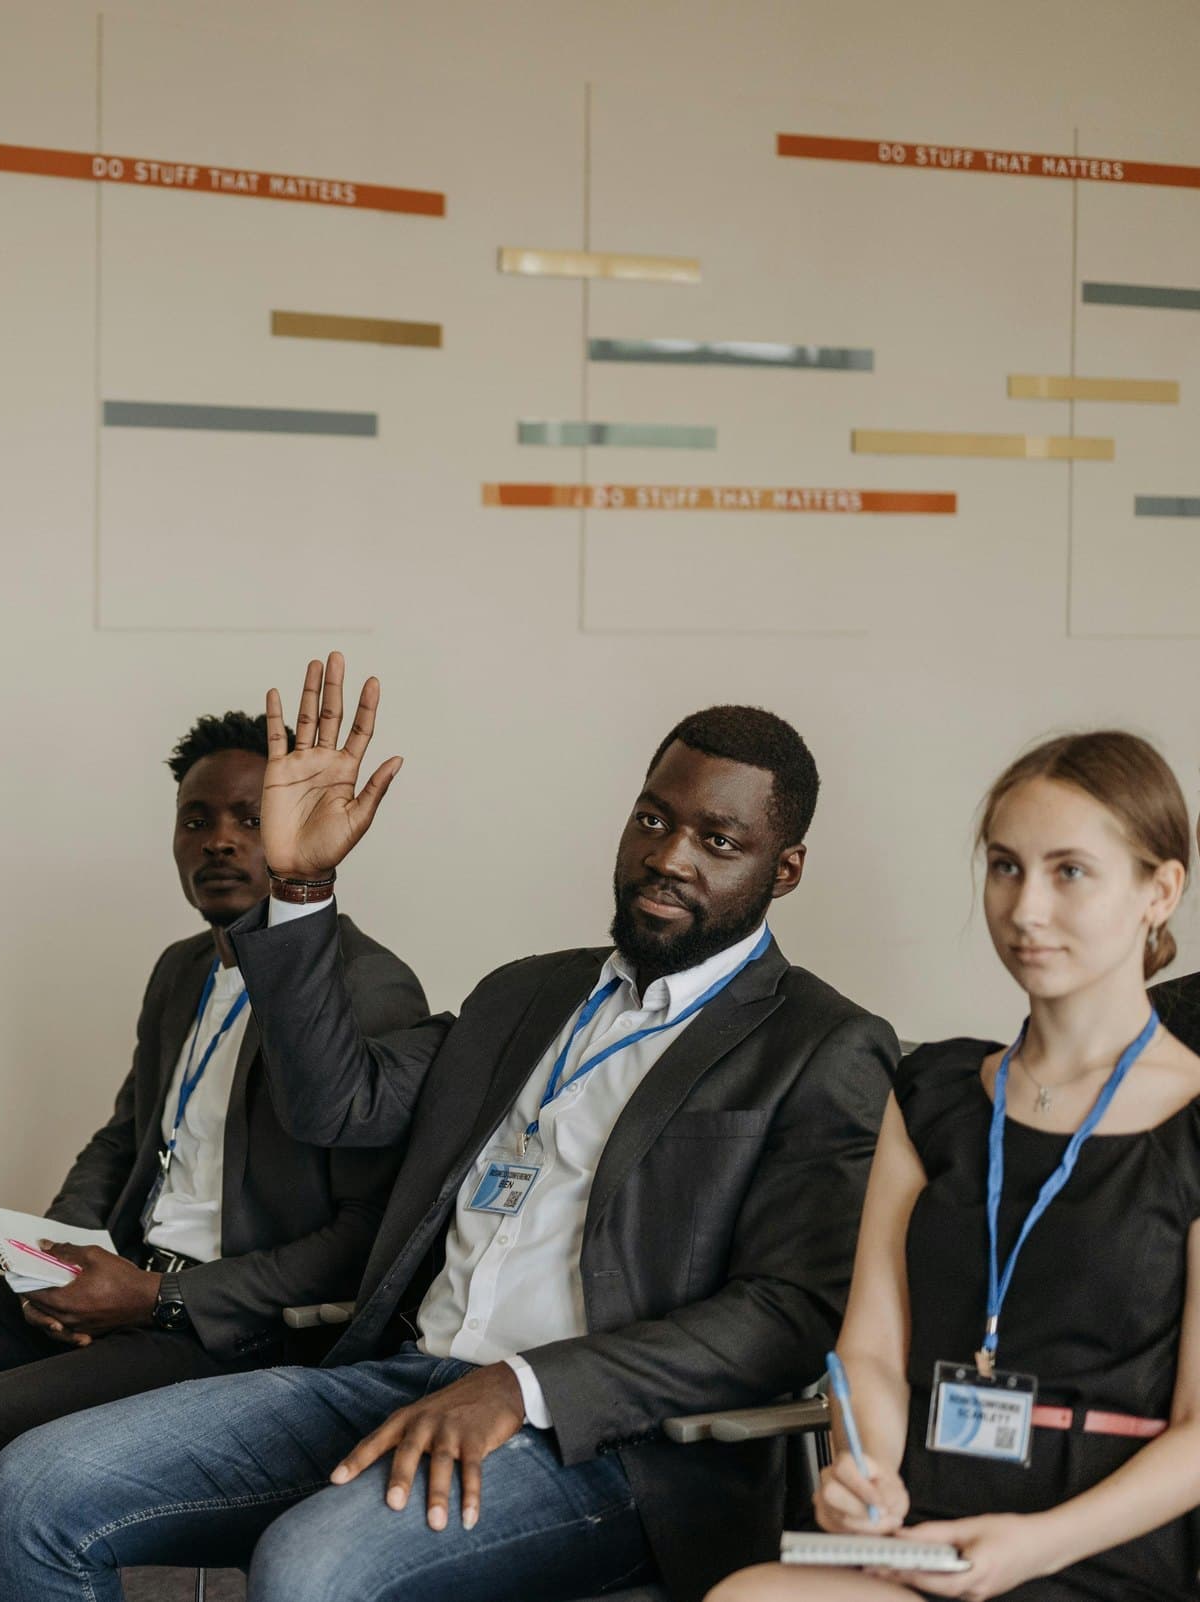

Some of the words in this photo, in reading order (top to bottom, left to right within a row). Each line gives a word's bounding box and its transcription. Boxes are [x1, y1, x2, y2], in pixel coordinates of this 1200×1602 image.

[878, 142, 906, 163] DO
[914, 146, 974, 168] STUFF
[984, 151, 1031, 173] THAT
[1042, 157, 1125, 180] MATTERS
[91, 157, 124, 179] DO
[133, 161, 199, 185] STUFF
[208, 168, 260, 193] THAT
[269, 175, 357, 203] MATTERS
[595, 487, 625, 507] DO
[636, 488, 701, 508] STUFF
[711, 488, 762, 509] THAT
[773, 490, 864, 512] MATTERS
[498, 1179, 514, 1189] BEN
